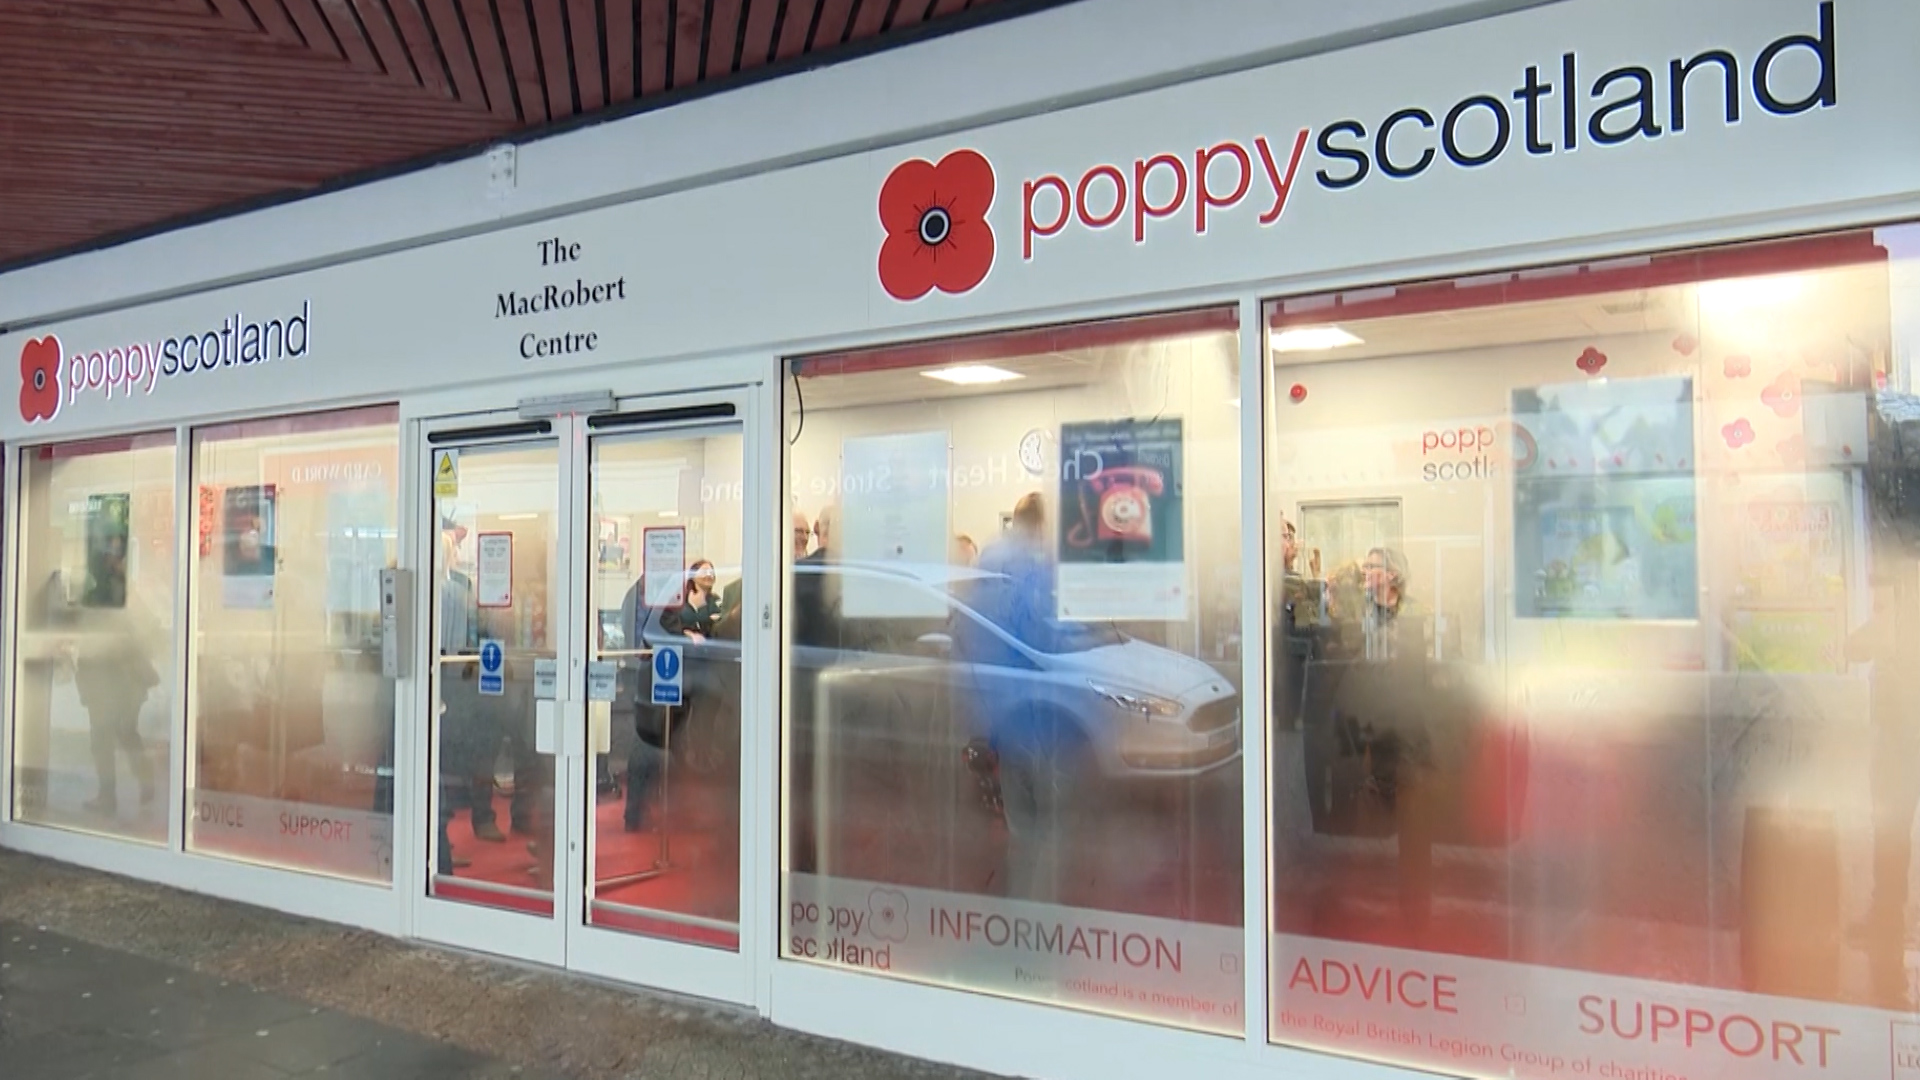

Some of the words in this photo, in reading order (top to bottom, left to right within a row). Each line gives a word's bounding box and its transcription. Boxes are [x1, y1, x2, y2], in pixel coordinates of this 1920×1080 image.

[1022, 2, 1838, 260] poppyscotland
[537, 237, 581, 267] The
[494, 276, 626, 319] MacRobert
[69, 300, 310, 405] poppyscotland
[519, 330, 598, 360] Centre
[1423, 427, 1494, 455] popp
[1423, 455, 1493, 482] scotl
[279, 812, 352, 842] SUPPORT
[929, 907, 1182, 973] INFORMATION
[1123, 985, 1135, 999] is
[1138, 991, 1147, 1001] a
[1152, 993, 1217, 1013] member
[1222, 1001, 1238, 1017] of
[1288, 957, 1458, 1013] ADVICE
[1578, 995, 1841, 1068] SUPPORT
[1280, 1010, 1307, 1027] the
[1313, 1014, 1360, 1036] Royal
[1367, 1022, 1422, 1046] British
[1429, 1032, 1494, 1058] Legion
[1500, 1043, 1564, 1073] Group
[1572, 1057, 1592, 1073] of
